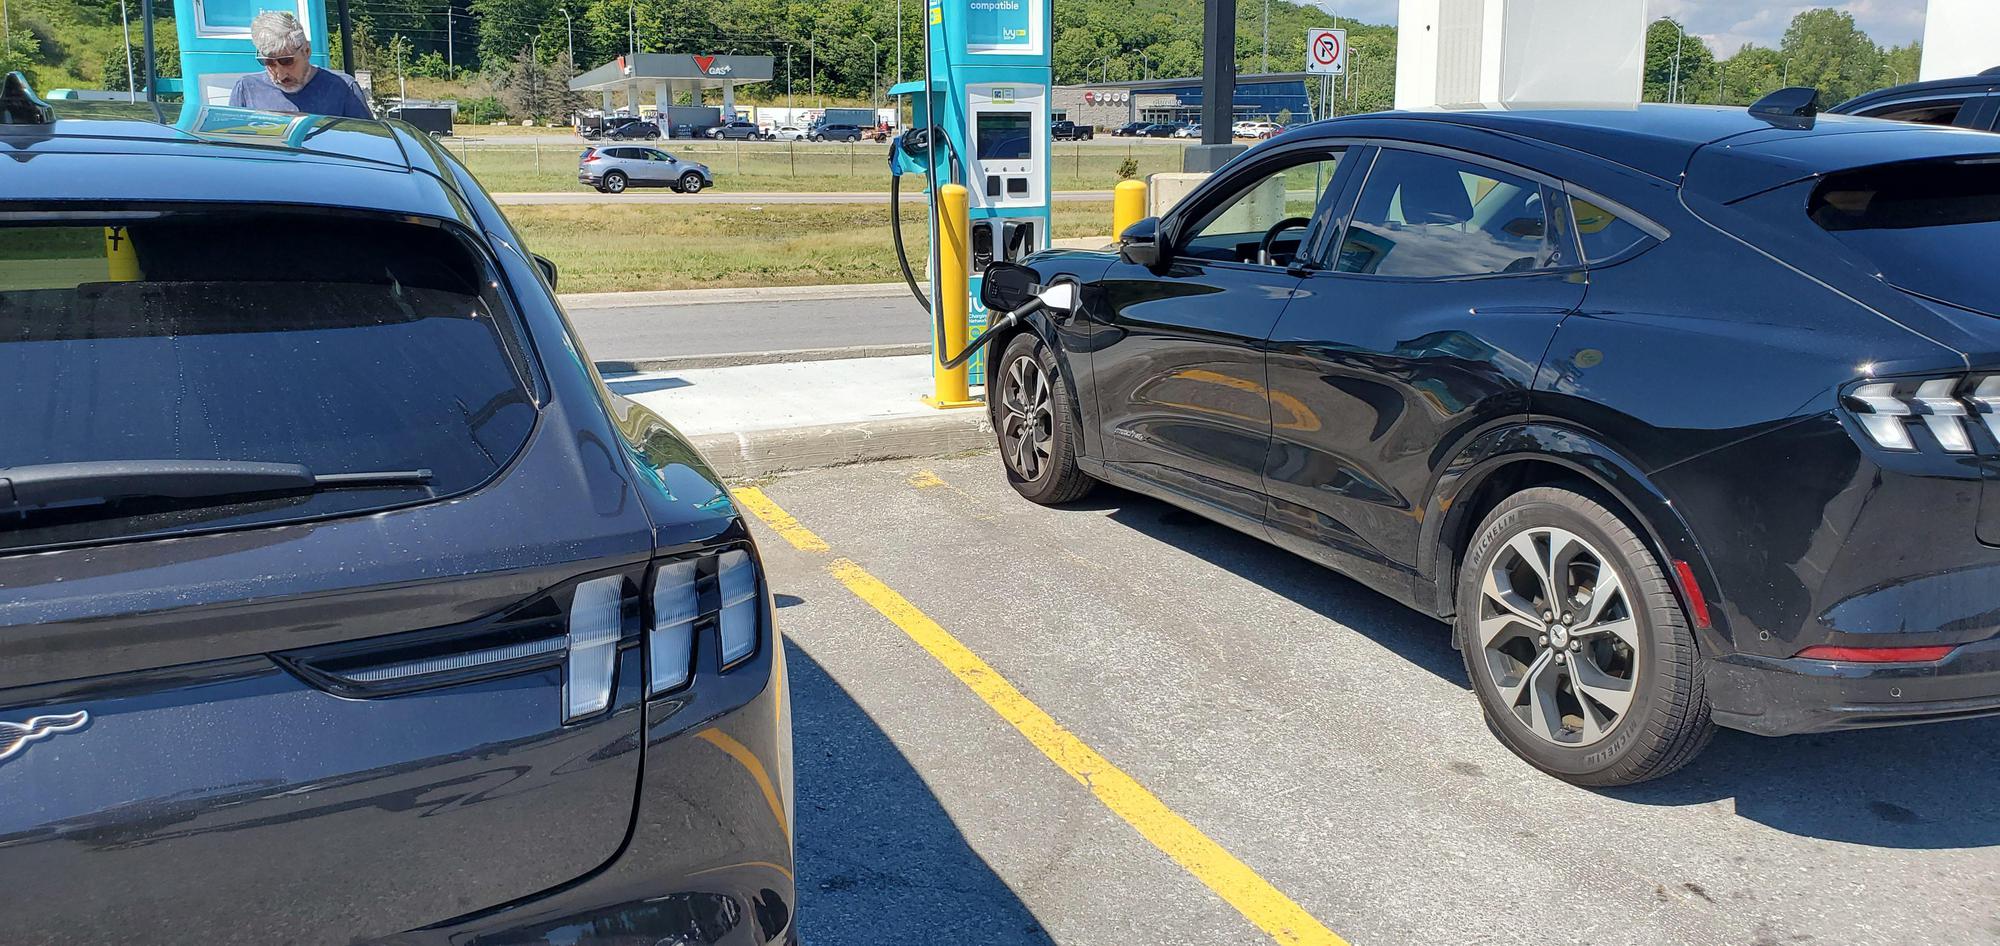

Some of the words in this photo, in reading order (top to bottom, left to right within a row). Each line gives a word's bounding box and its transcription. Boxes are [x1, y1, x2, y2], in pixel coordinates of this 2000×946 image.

[970, 1, 1019, 12] compatible
[1473, 514, 1515, 565] MICHELIN
[1587, 719, 1637, 765] MICHELIN
